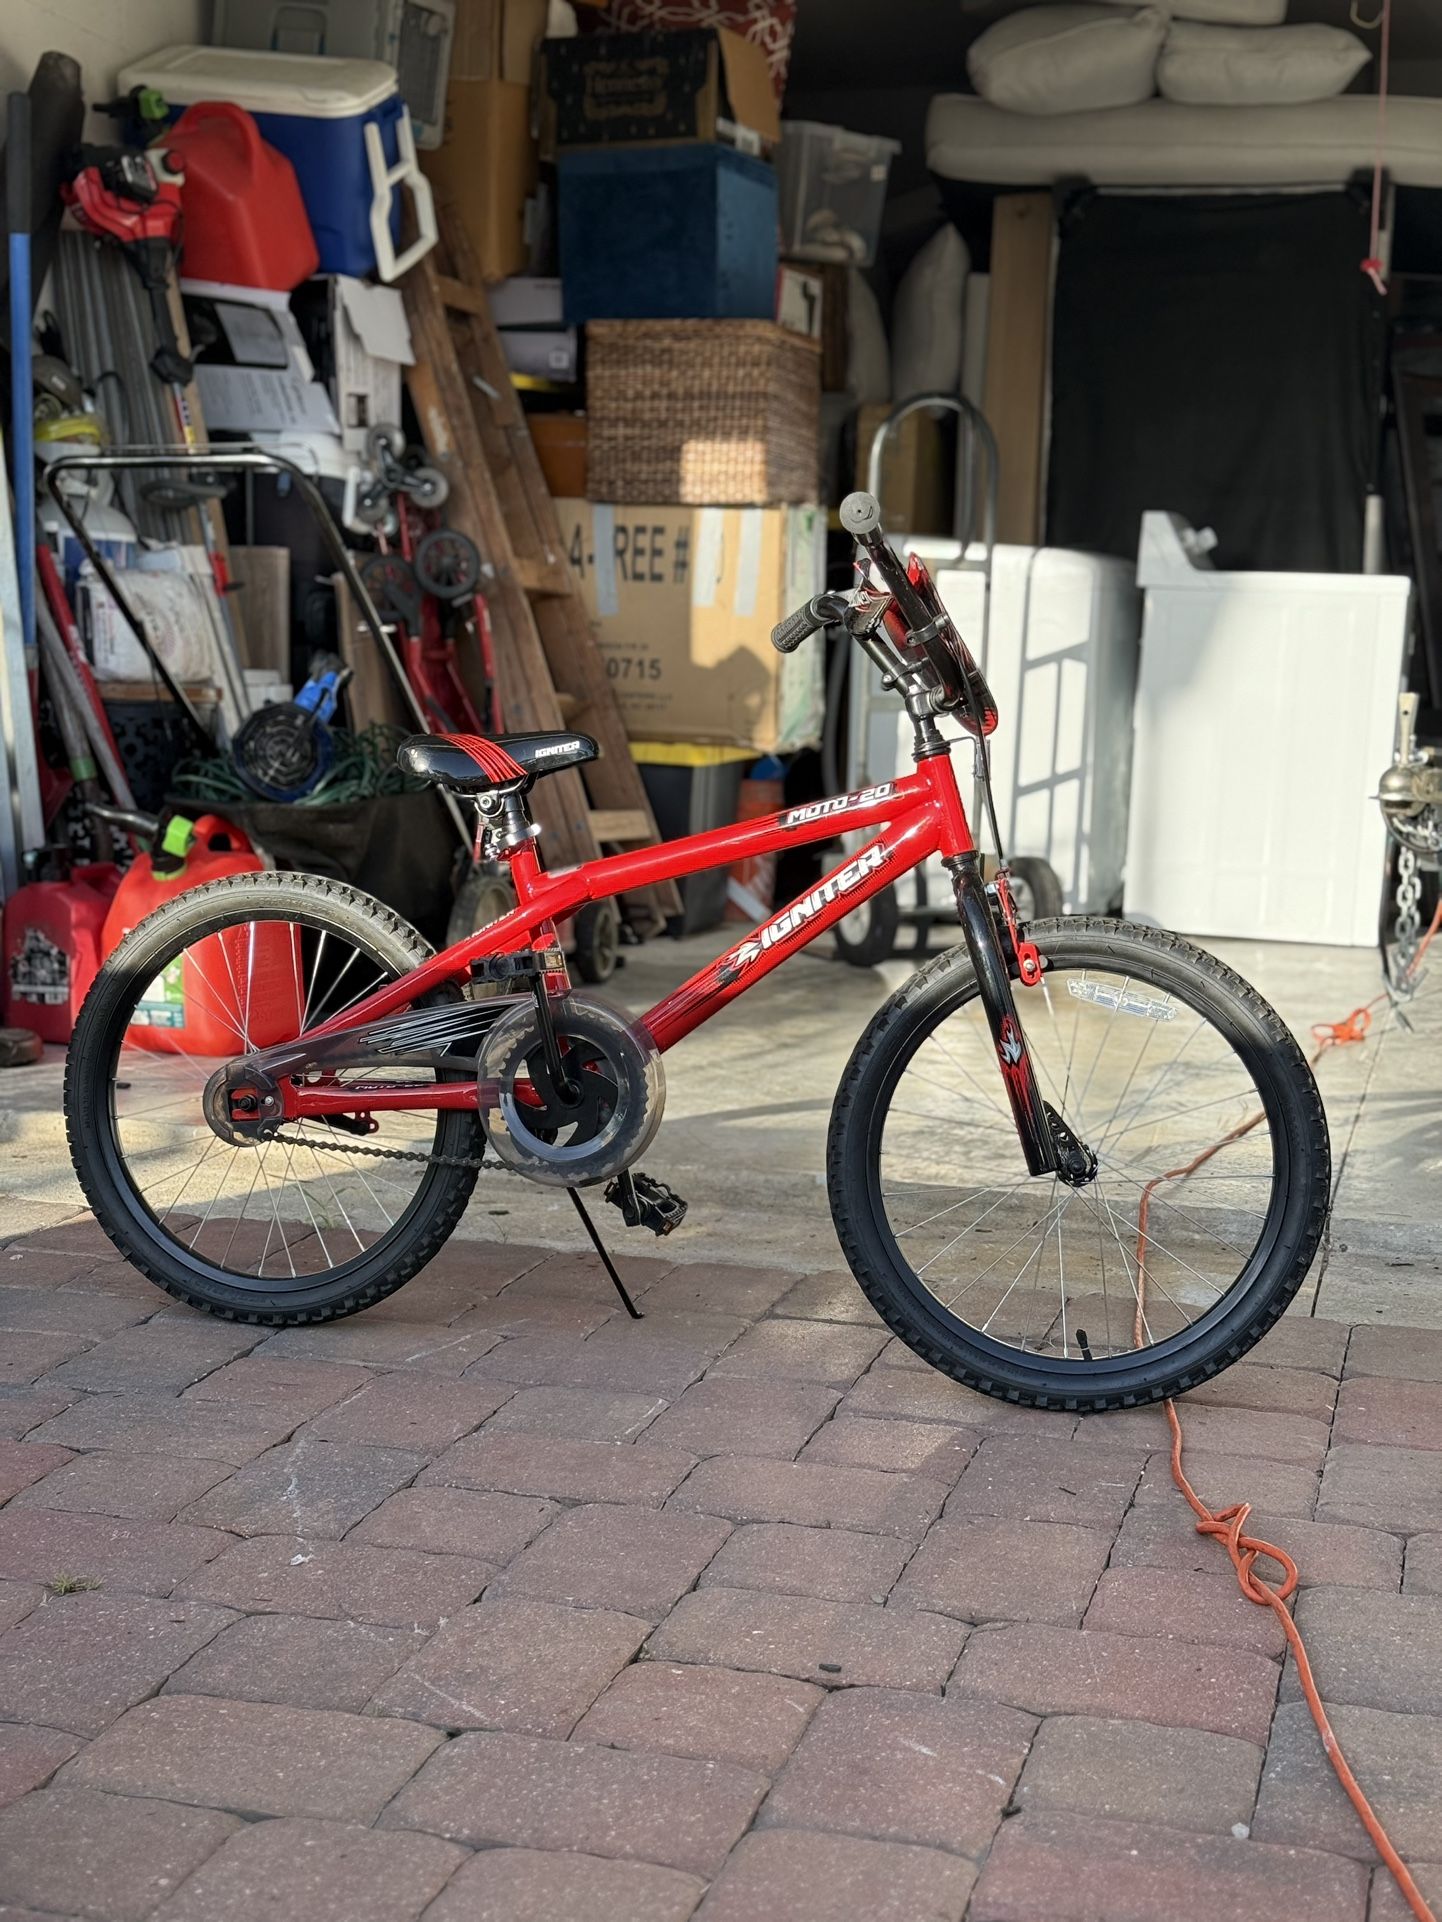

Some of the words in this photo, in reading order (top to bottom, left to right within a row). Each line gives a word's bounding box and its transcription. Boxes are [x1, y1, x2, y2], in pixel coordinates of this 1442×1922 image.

[534, 740, 580, 759] IGNITER
[786, 782, 892, 826] MOTO-20
[759, 843, 886, 950] IGNITER
